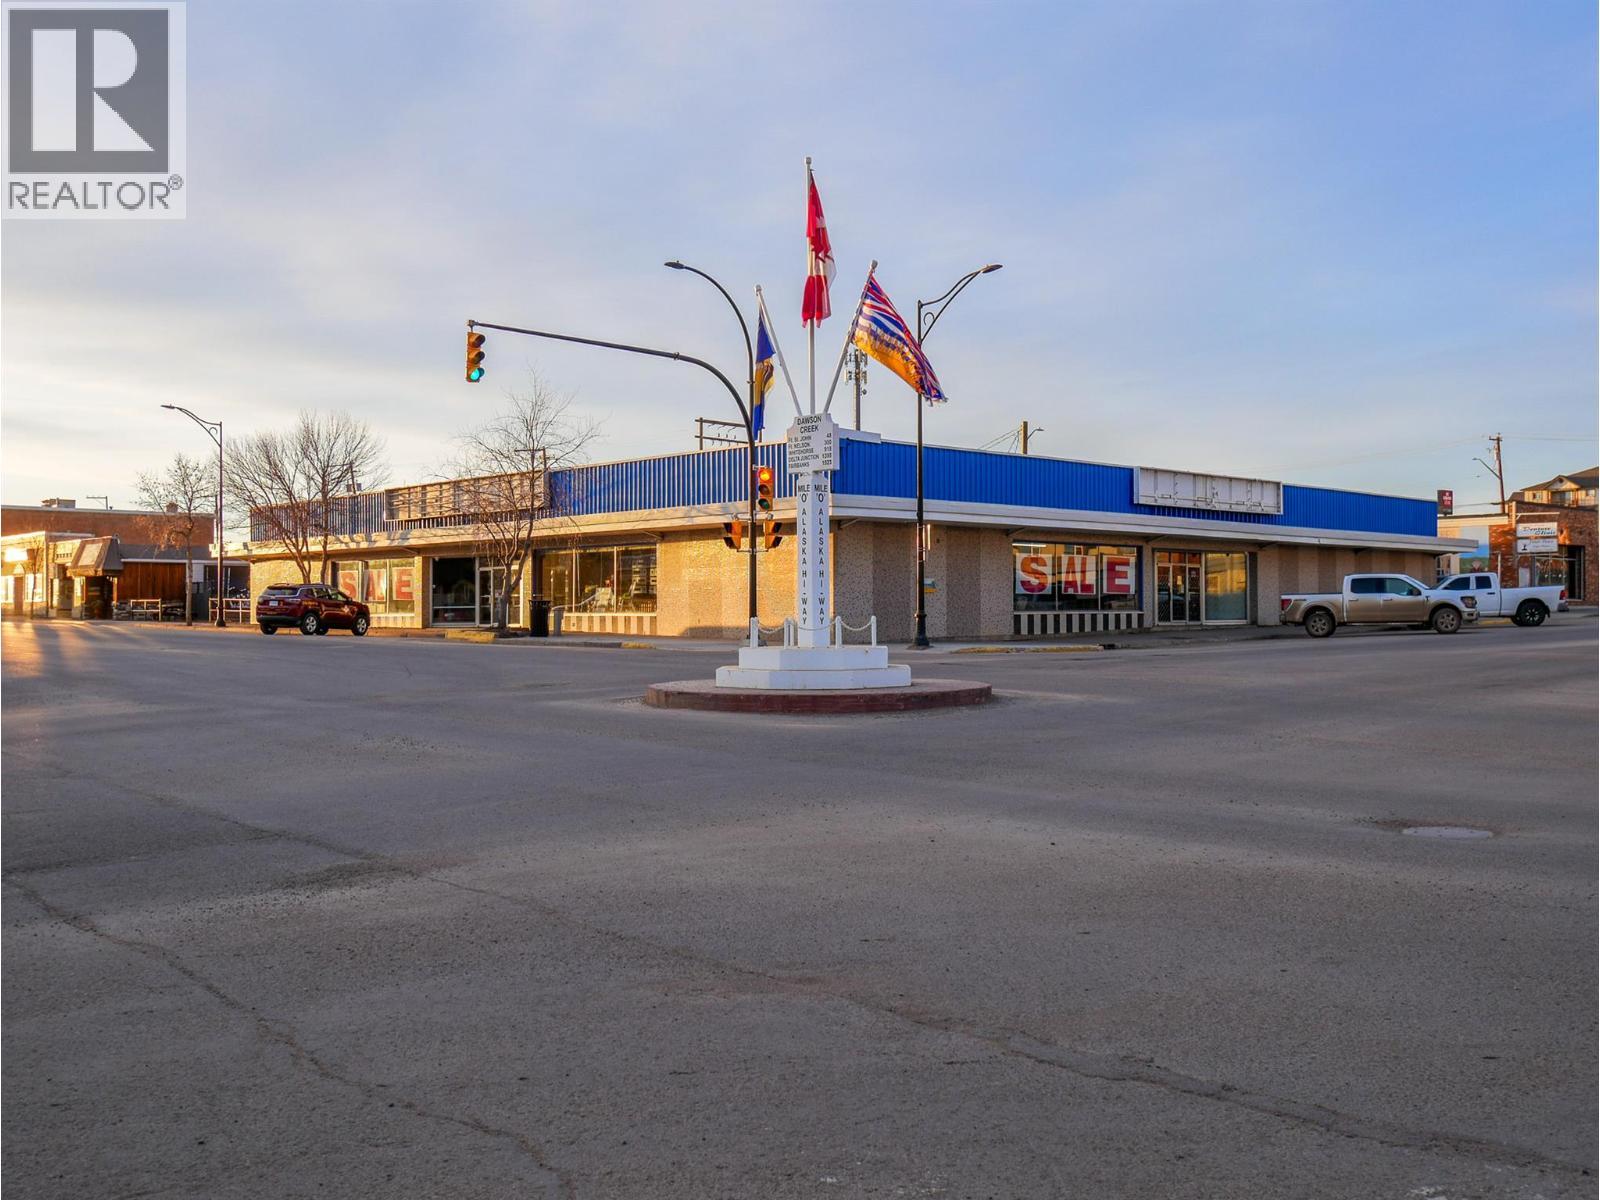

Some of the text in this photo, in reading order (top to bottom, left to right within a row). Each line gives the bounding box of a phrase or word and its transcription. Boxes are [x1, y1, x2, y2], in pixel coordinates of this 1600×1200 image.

[797, 415, 822, 425] DAWSON
[800, 425, 819, 434] CREEK
[788, 448, 814, 456] WHITEHORSE
[798, 484, 811, 492] MILE
[814, 484, 828, 492] MILE
[1020, 555, 1131, 593] SALE
[340, 569, 414, 602] SALE
